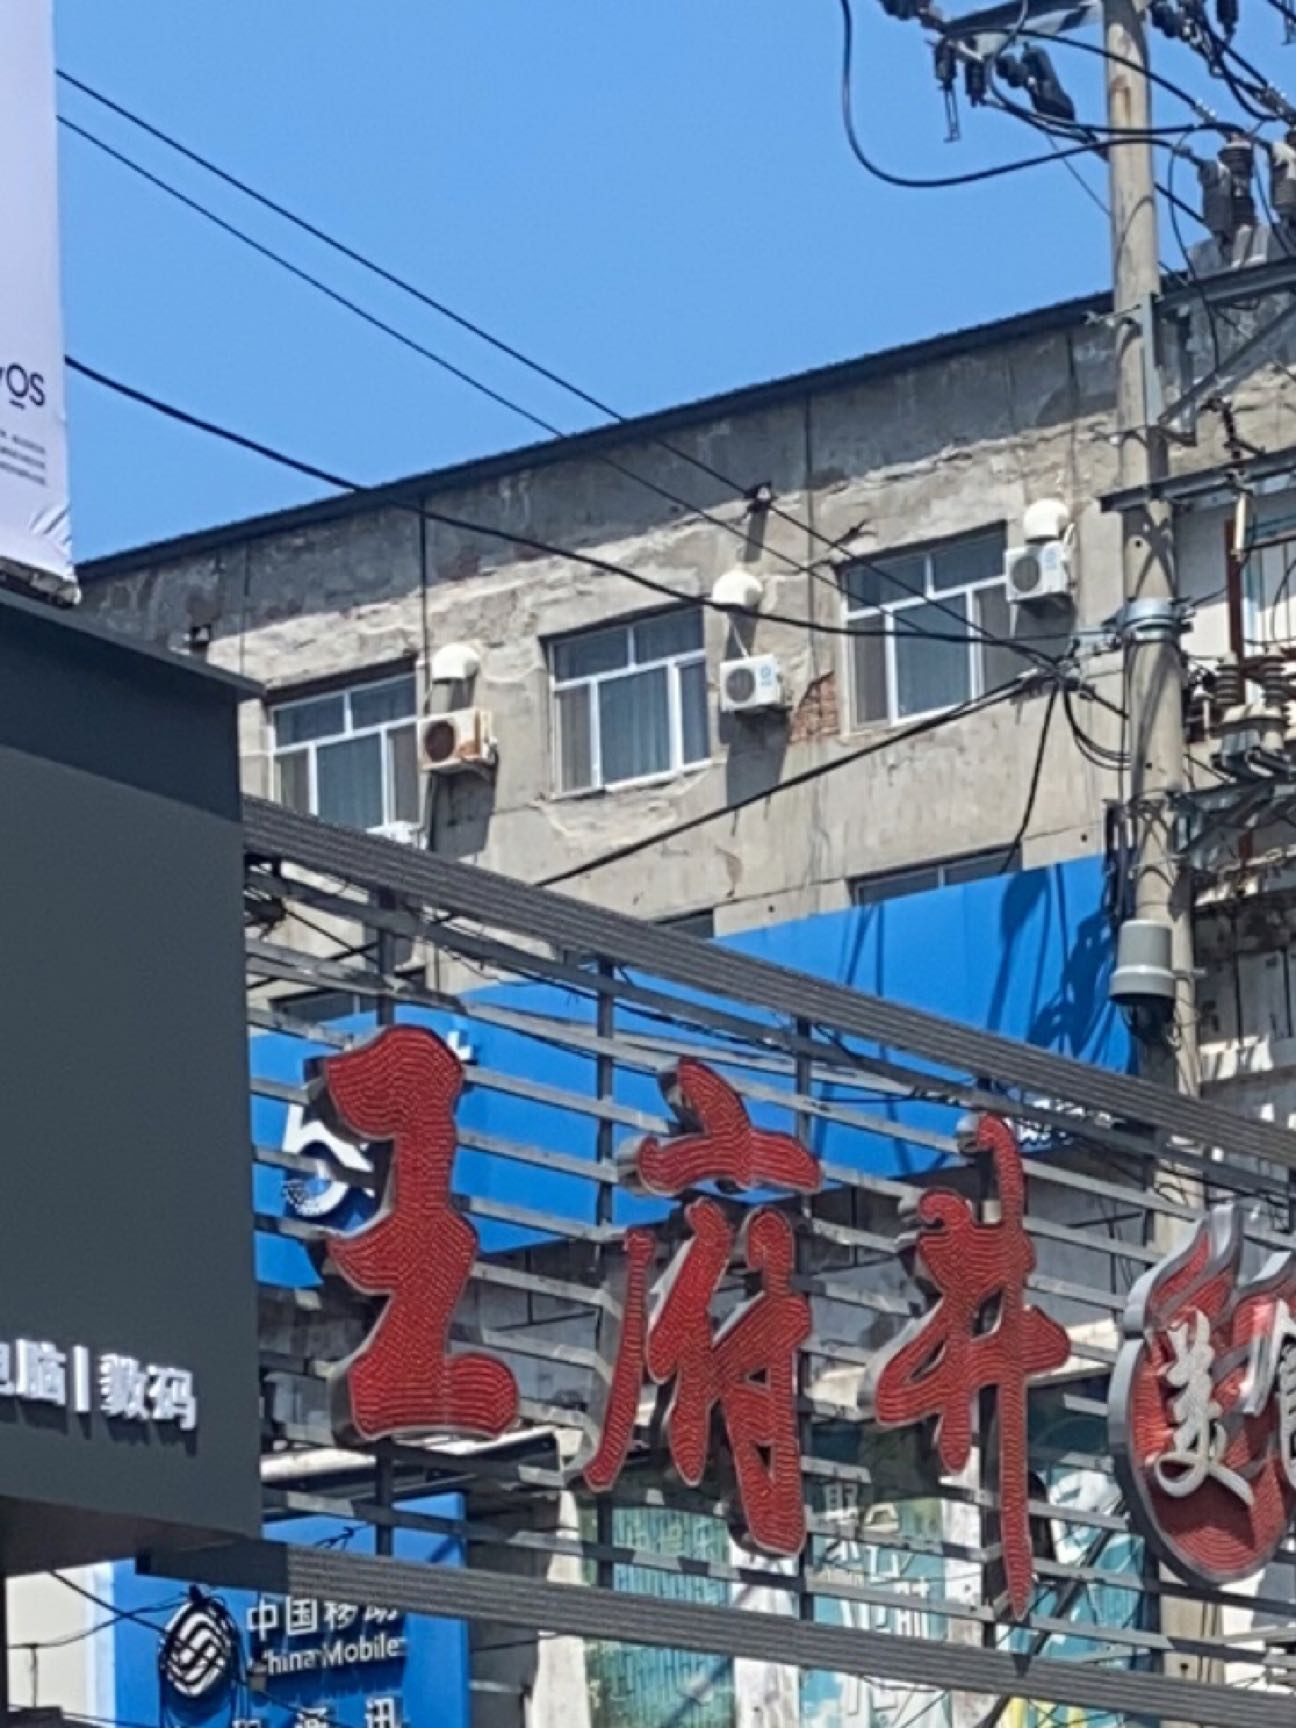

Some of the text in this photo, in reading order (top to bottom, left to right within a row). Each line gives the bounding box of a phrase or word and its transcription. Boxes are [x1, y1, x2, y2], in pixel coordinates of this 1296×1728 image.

[322, 1024, 1073, 1622] 王府井
[98, 1353, 196, 1432] 数码
[249, 1634, 402, 1677] hina Mobile
